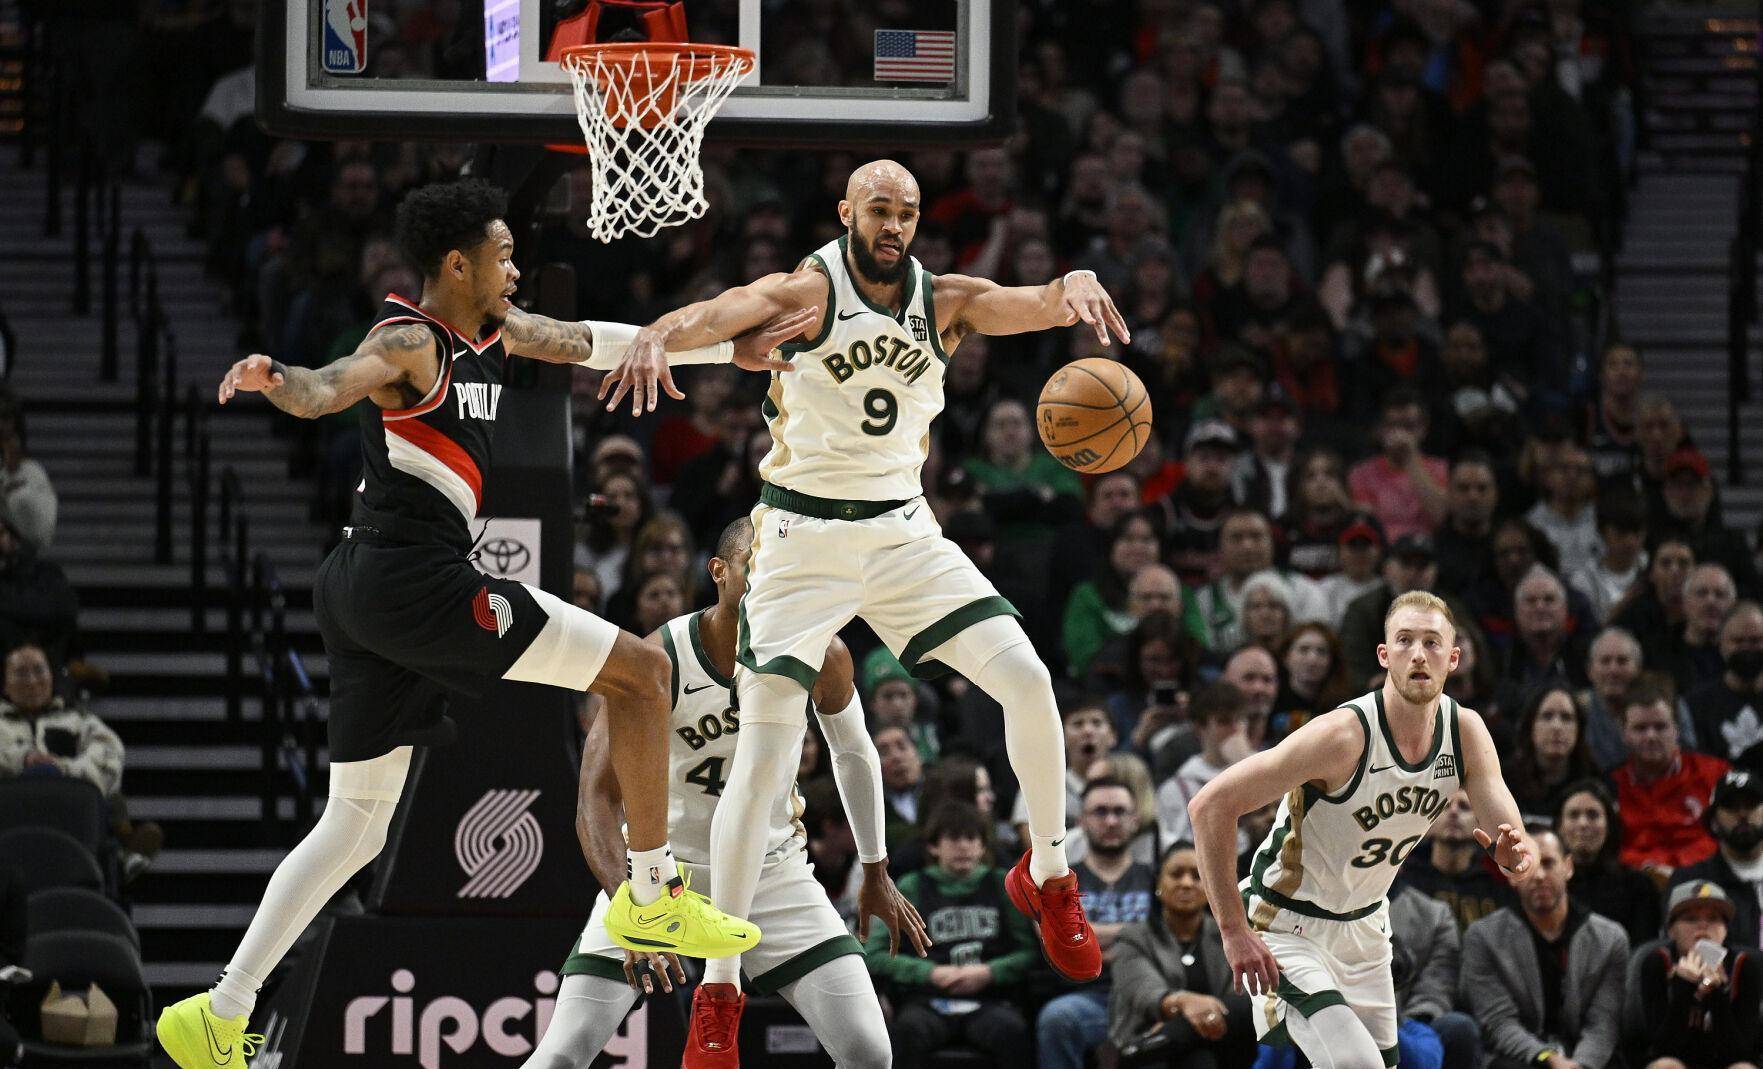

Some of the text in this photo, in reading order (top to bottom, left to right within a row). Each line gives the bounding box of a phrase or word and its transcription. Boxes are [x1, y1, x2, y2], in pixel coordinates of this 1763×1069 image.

[329, 50, 350, 66] NBA
[909, 318, 926, 331] STA
[822, 334, 931, 386] BOSTON
[861, 387, 898, 436] 9
[675, 706, 741, 751] BOS
[685, 755, 727, 798] 4
[1351, 834, 1422, 869] 30
[344, 968, 649, 1069] ripciy
